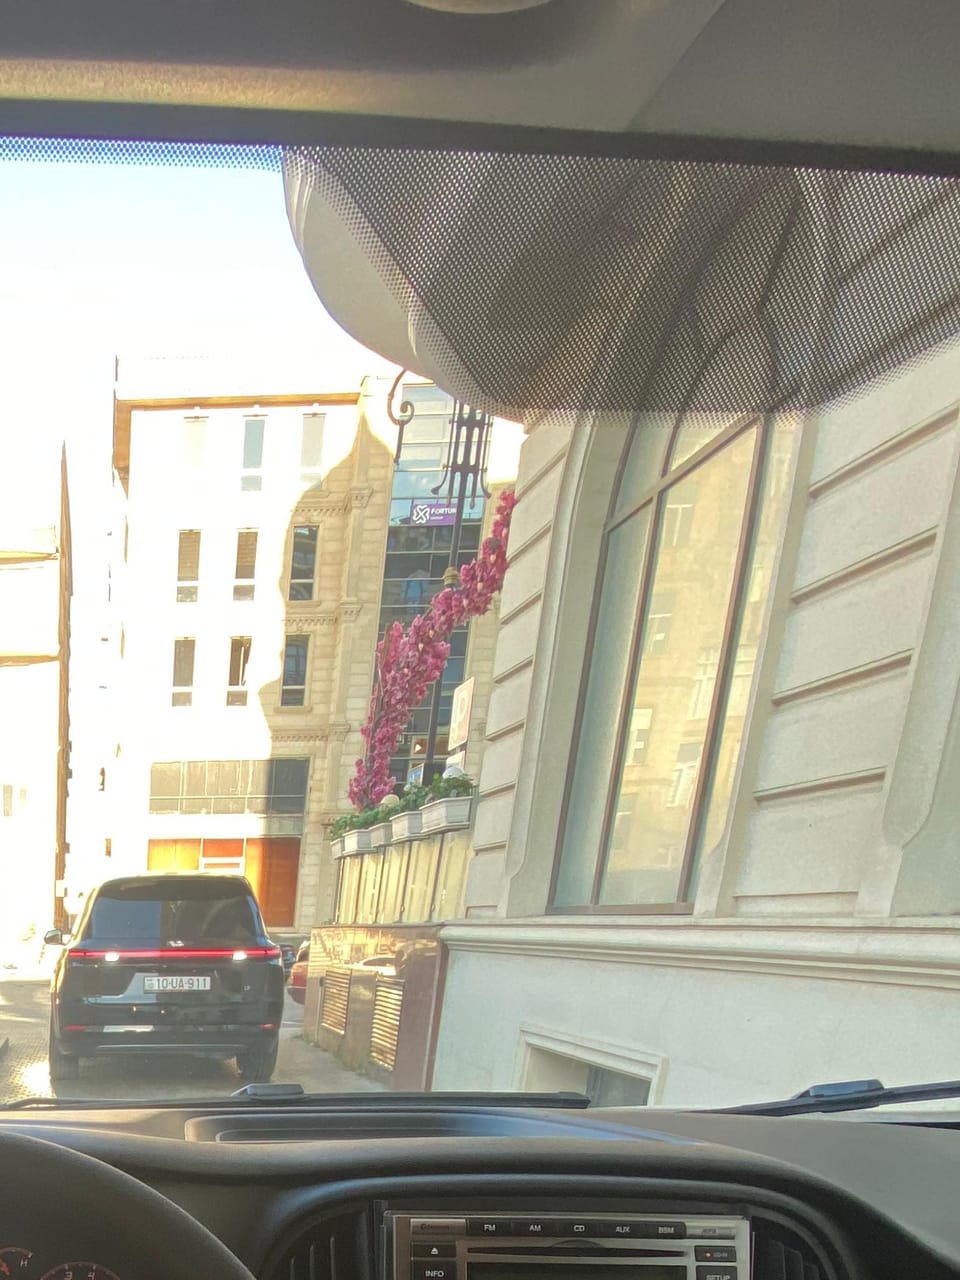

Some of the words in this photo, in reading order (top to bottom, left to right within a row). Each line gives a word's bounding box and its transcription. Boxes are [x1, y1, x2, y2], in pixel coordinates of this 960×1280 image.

[156, 977, 207, 989] 10-UA-911
[484, 1223, 497, 1232] FM
[529, 1224, 542, 1232] AM
[573, 1224, 585, 1232] CD
[615, 1226, 631, 1234] AUX
[64, 1271, 73, 1280] 3
[87, 1271, 96, 1280] 4
[425, 1270, 445, 1278] INFO
